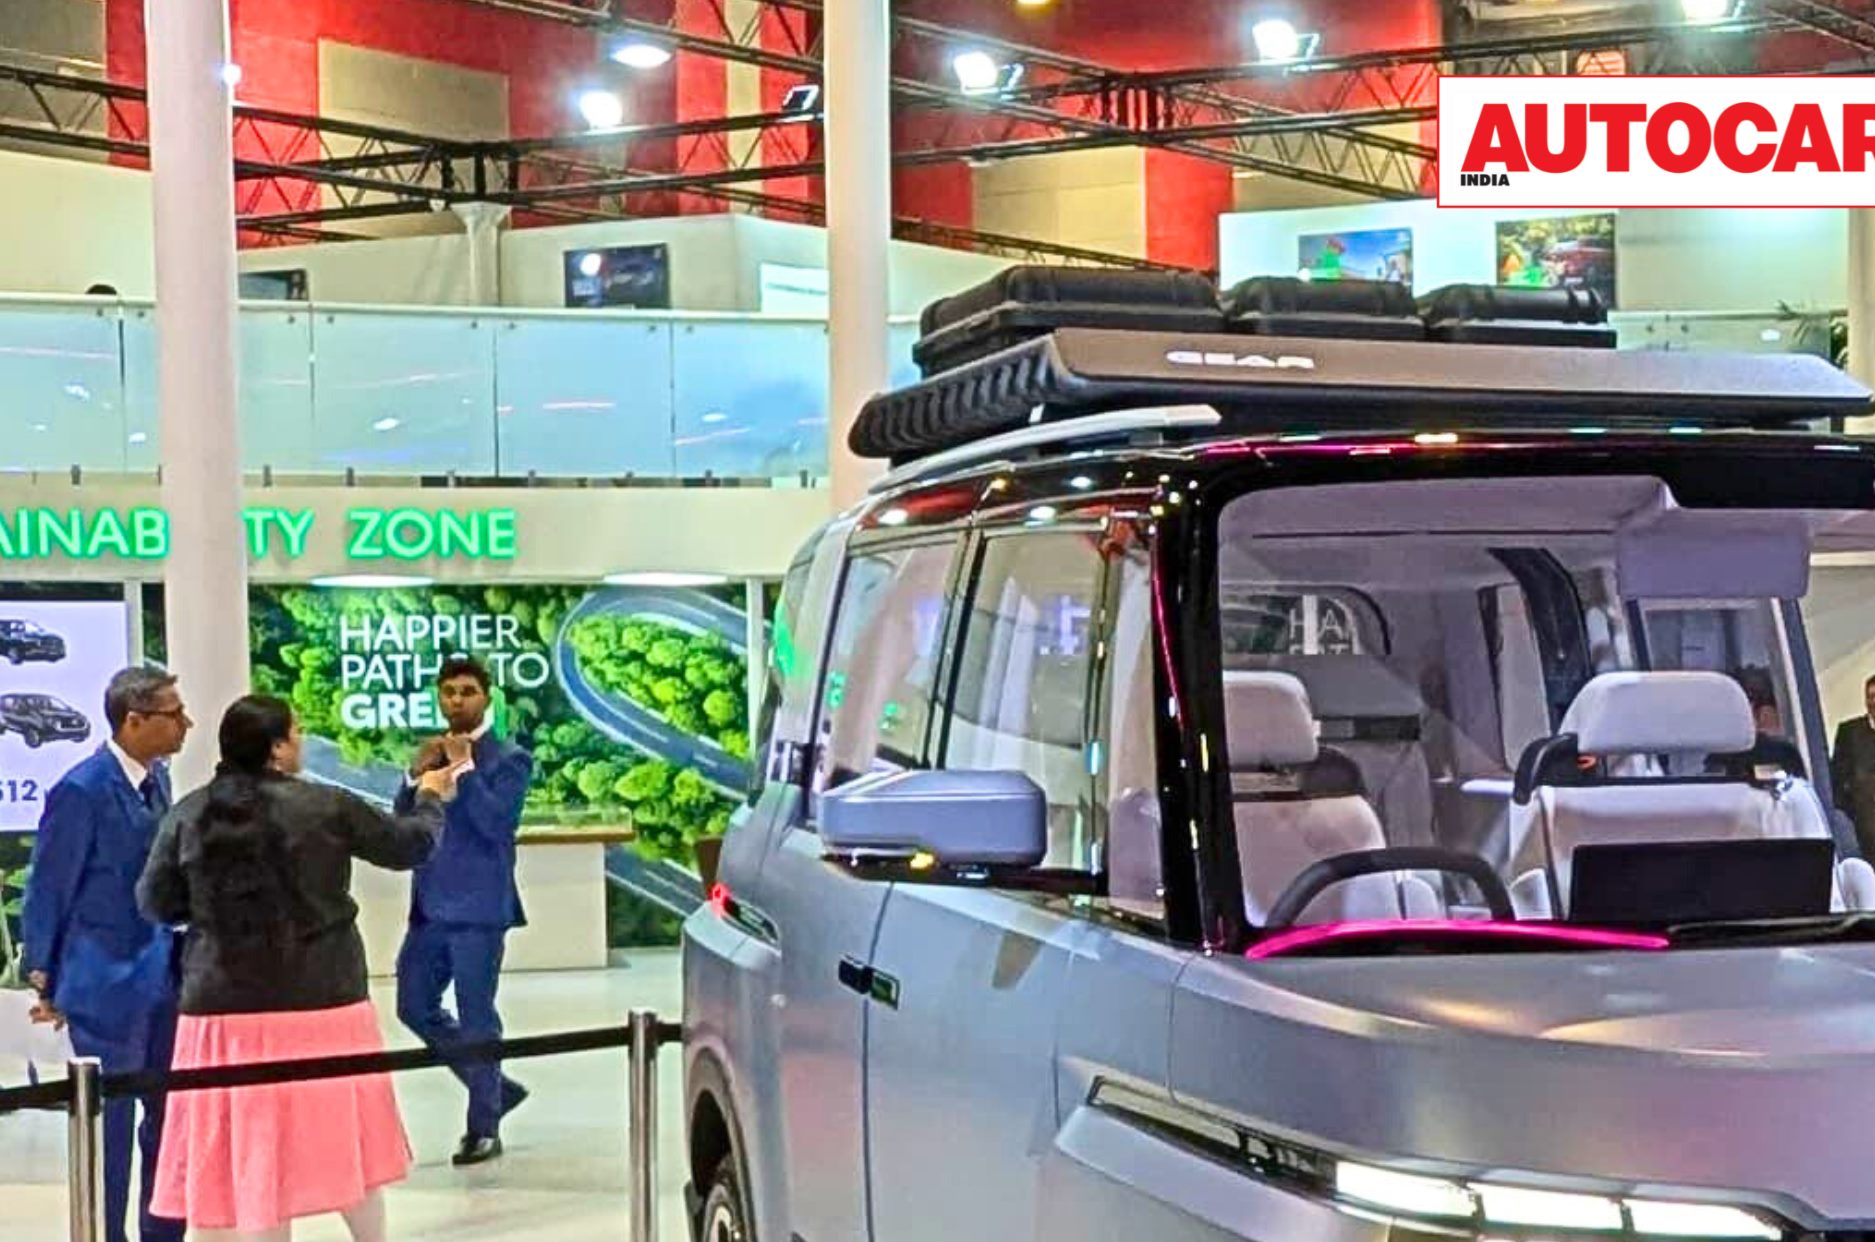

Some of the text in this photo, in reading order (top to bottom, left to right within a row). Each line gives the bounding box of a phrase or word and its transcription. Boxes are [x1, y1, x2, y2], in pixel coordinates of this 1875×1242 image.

[349, 509, 515, 558] ZONE
[340, 614, 521, 650] HAPPIER
[341, 652, 549, 689] PATH TO
[340, 692, 494, 730] GRE
